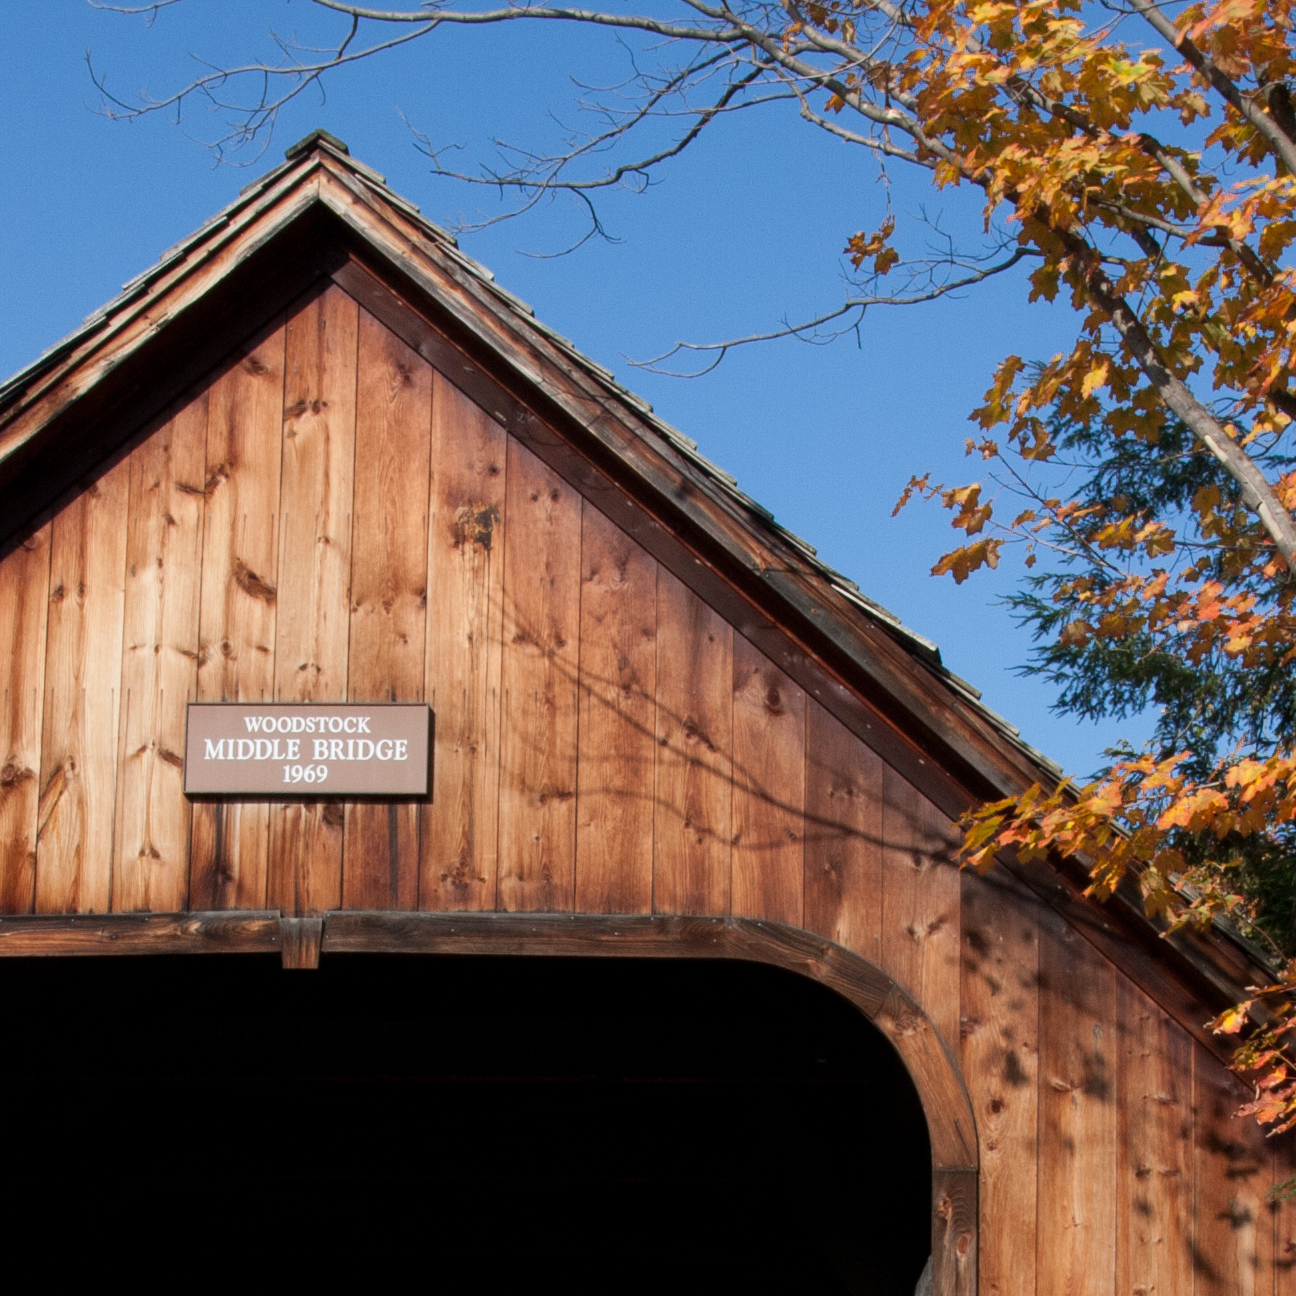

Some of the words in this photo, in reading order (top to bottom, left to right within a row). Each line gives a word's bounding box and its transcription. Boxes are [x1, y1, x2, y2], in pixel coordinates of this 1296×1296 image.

[244, 716, 371, 734] WOODSTOCK
[204, 738, 301, 761] MIDDLE
[312, 739, 408, 761] BRIDGE
[282, 764, 328, 784] 1969
